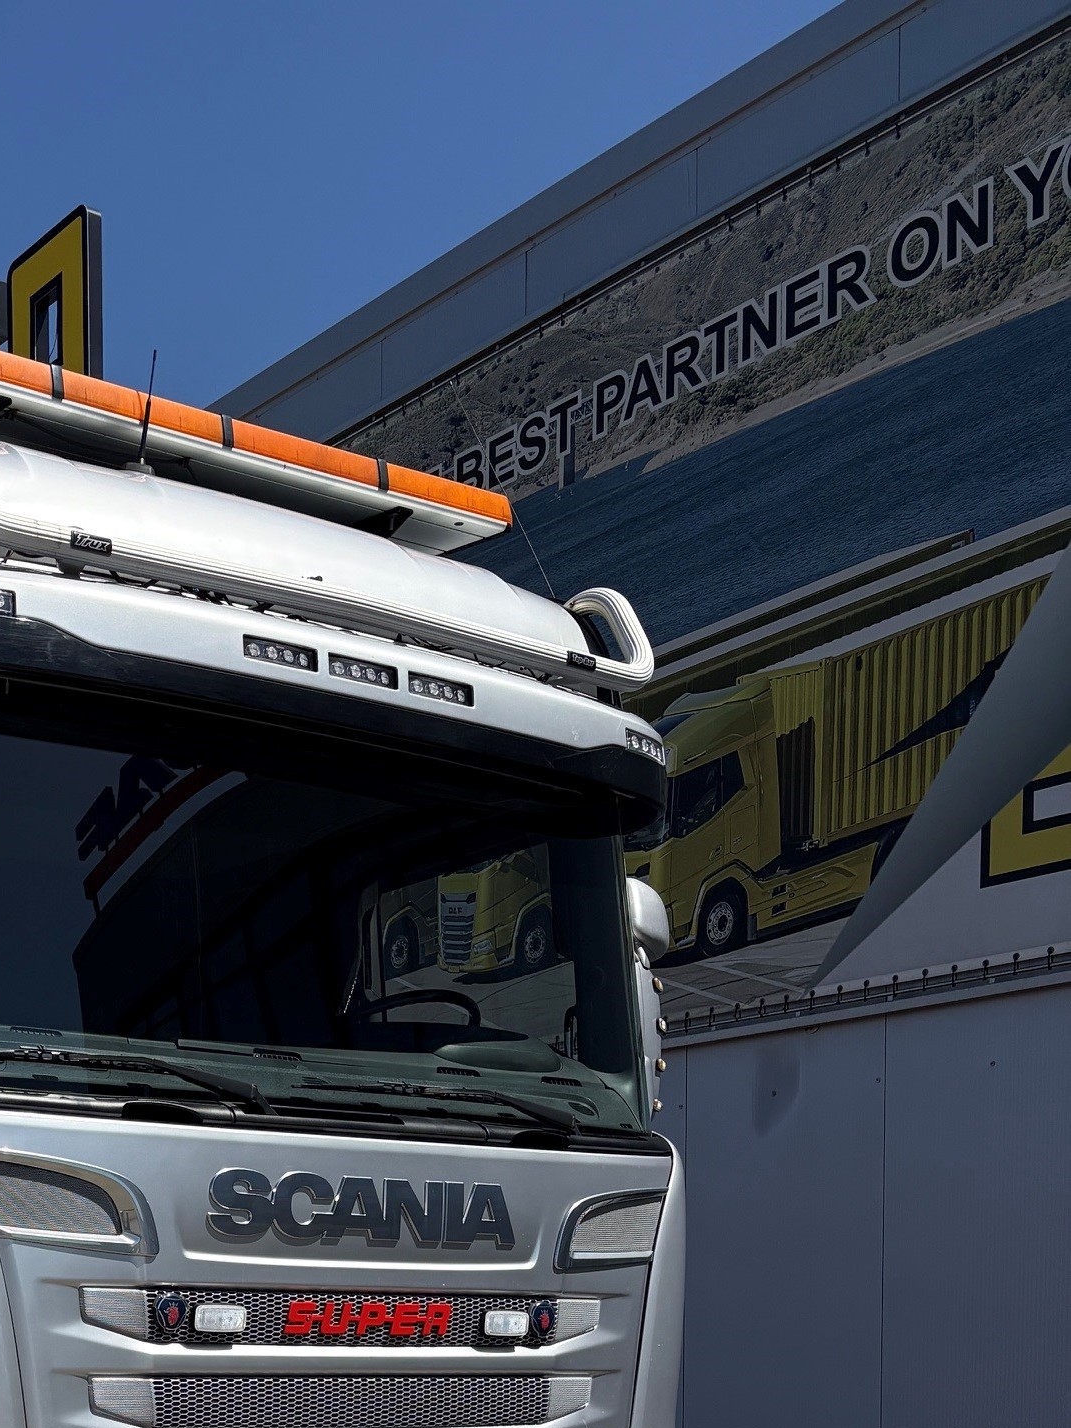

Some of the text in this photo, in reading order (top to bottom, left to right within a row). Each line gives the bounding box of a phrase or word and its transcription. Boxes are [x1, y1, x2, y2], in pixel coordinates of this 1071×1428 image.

[454, 139, 1071, 490] BEST PARTNER ON Y
[74, 533, 110, 551] Trux
[206, 1167, 515, 1250] SCANIA
[283, 1301, 452, 1336] SUPER
